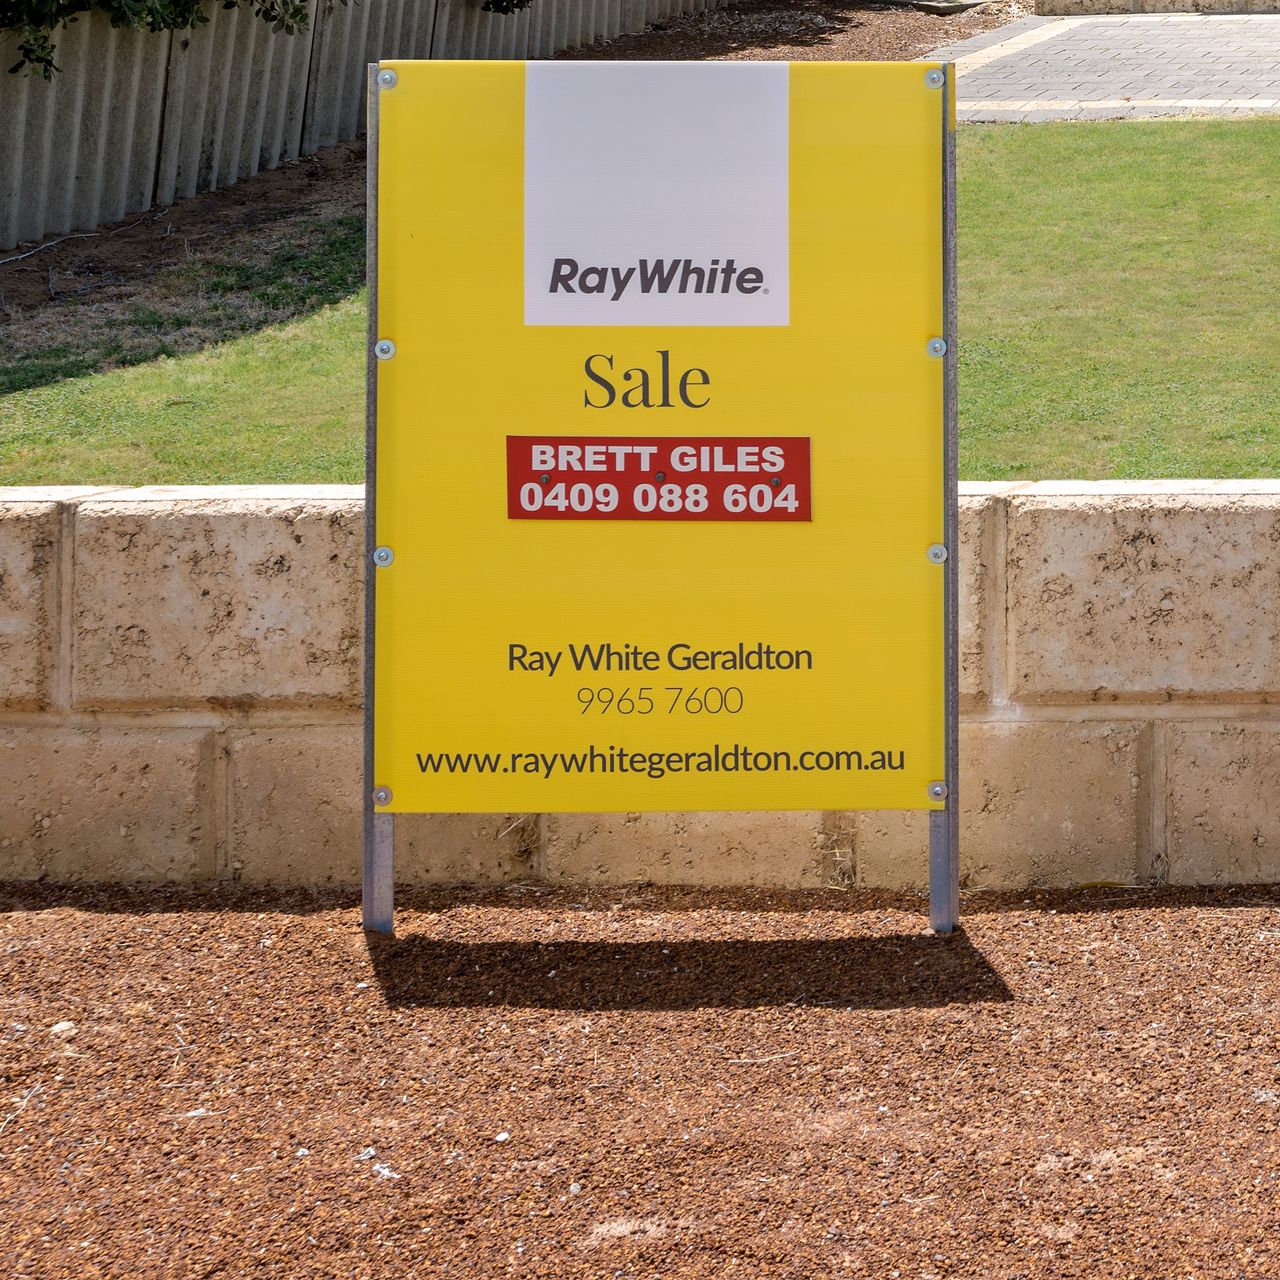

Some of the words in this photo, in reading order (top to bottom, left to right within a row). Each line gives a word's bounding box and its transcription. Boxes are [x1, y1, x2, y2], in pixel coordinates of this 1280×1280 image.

[584, 349, 711, 409] Sale
[531, 445, 658, 472] BRETT
[670, 445, 785, 473] GILES
[519, 483, 619, 513] 0409
[633, 483, 709, 513] 088
[723, 483, 799, 513] 604
[508, 643, 562, 678] Ray
[568, 642, 661, 671] White
[667, 642, 813, 671] Geraldton
[577, 687, 654, 715] 9965
[664, 686, 744, 715] 7600
[416, 743, 905, 779] www.raywhitegeraldton.com.au
